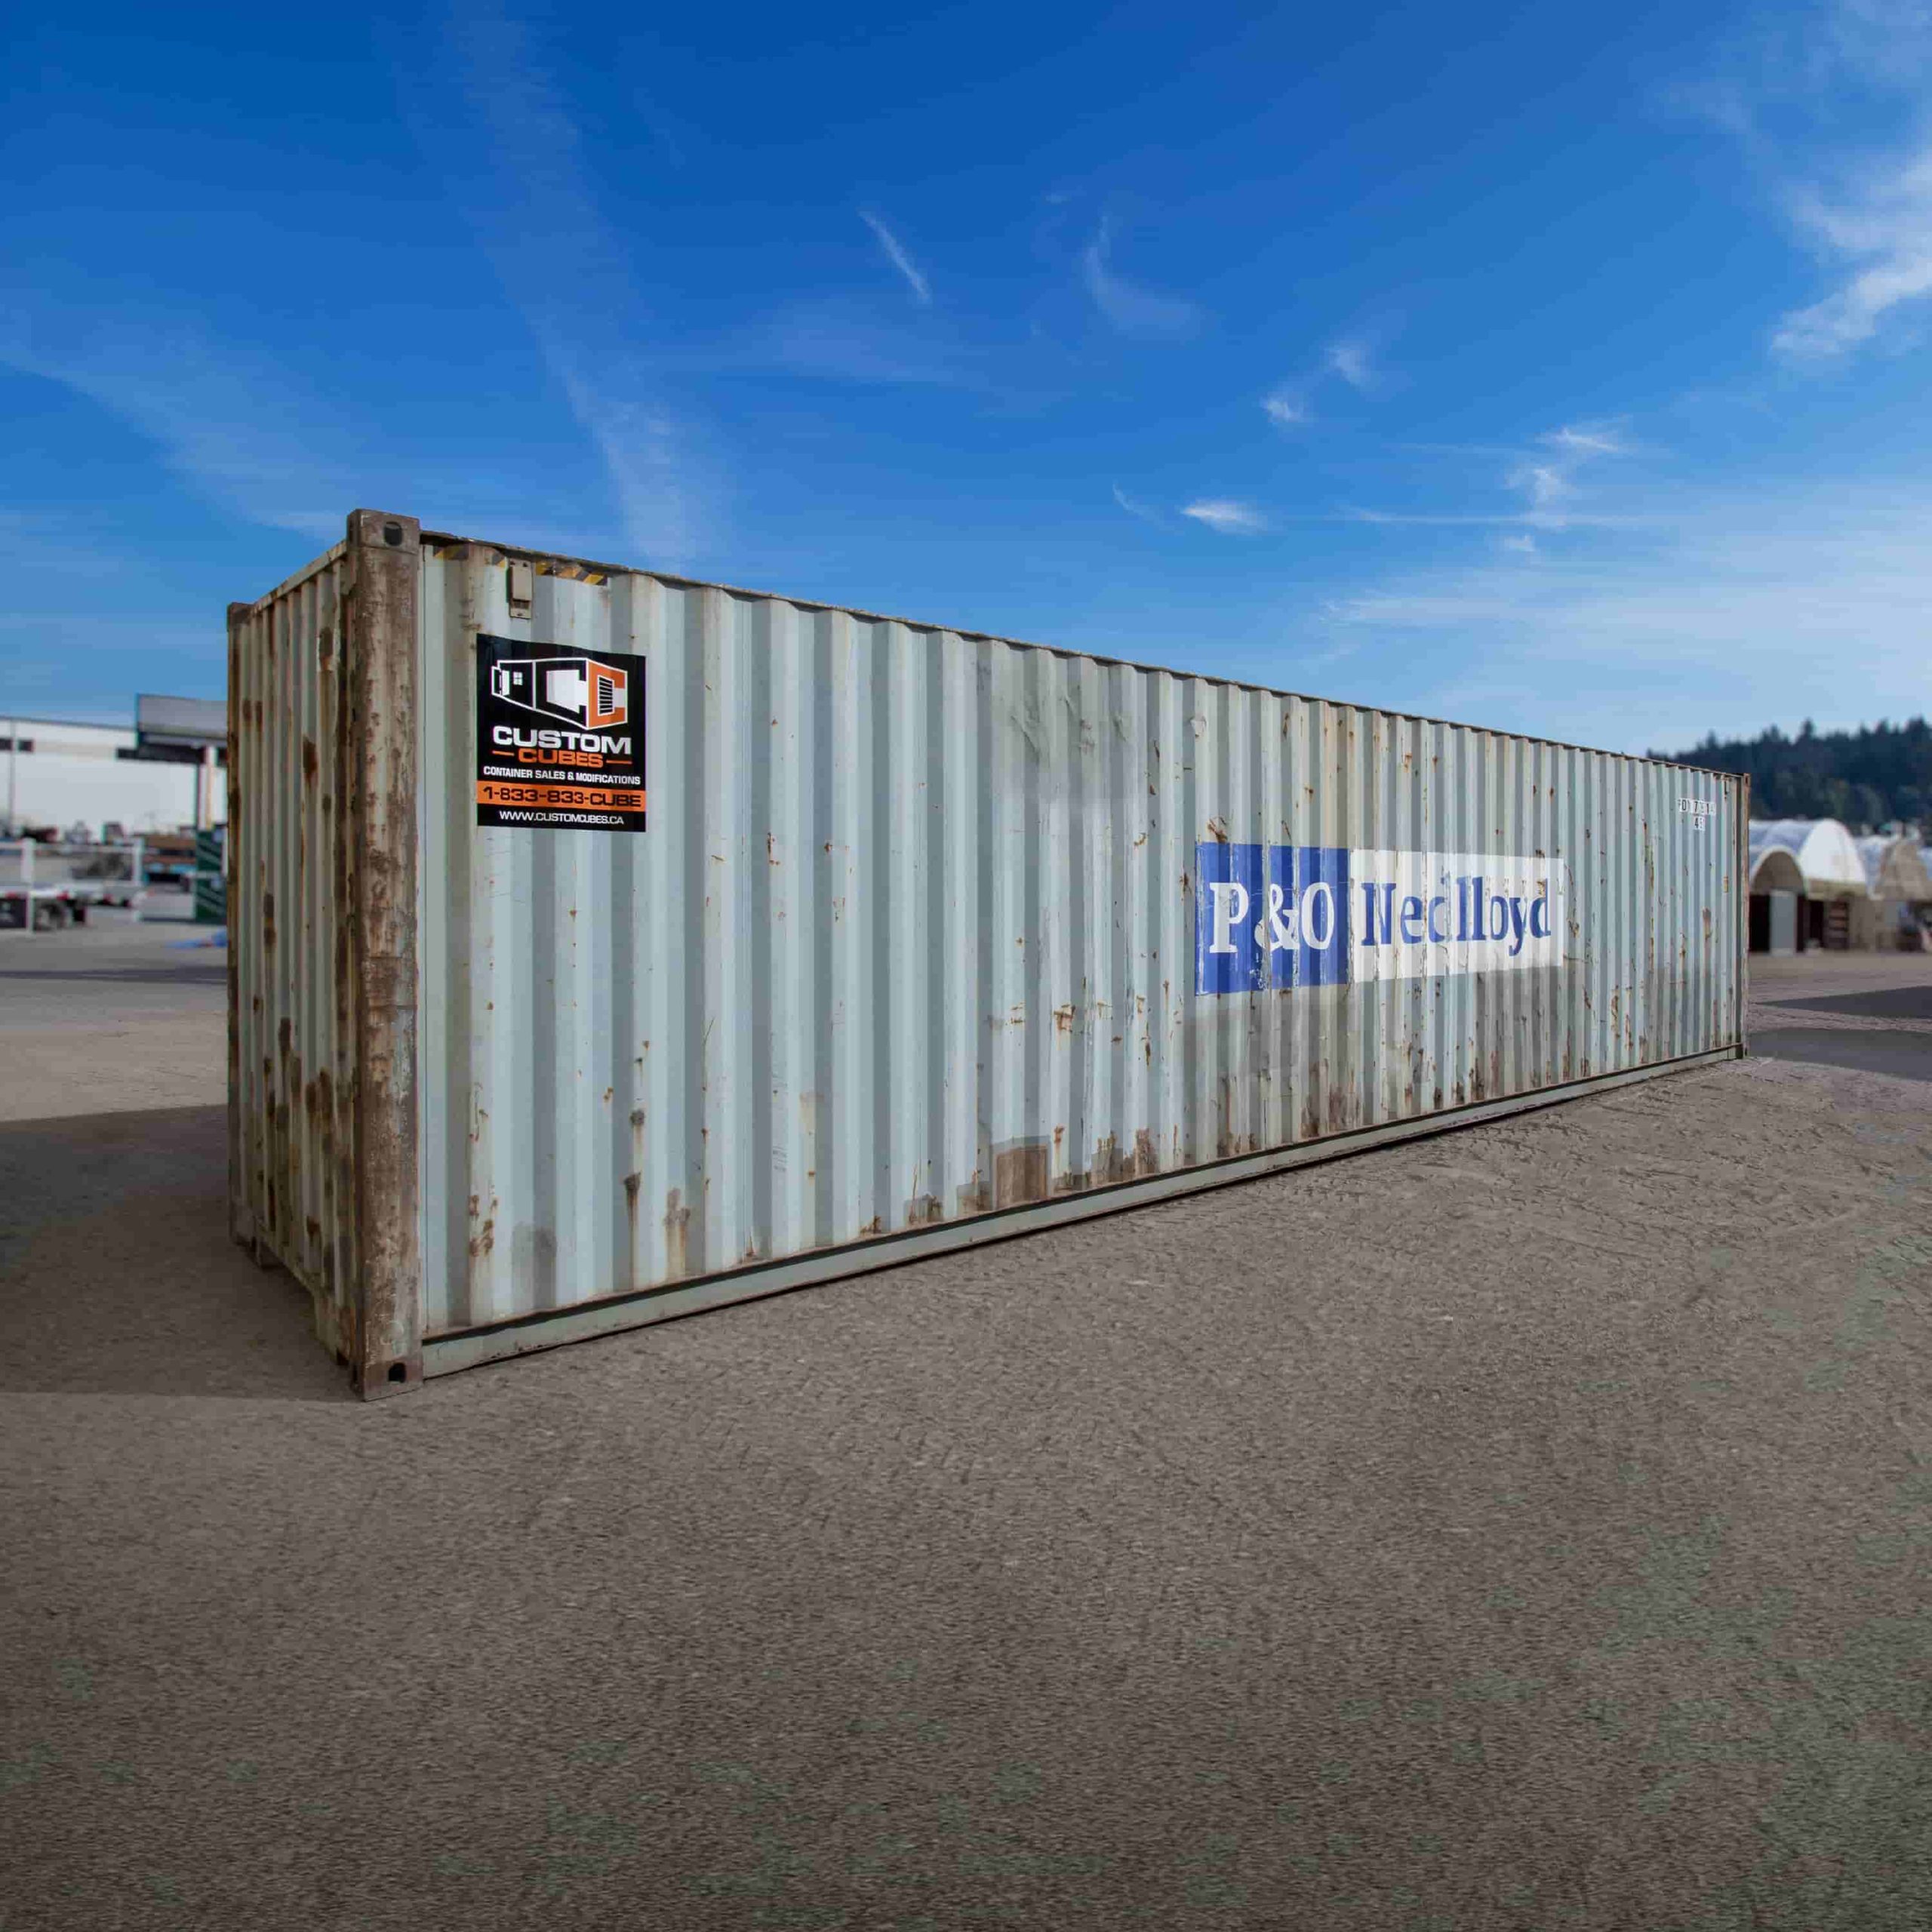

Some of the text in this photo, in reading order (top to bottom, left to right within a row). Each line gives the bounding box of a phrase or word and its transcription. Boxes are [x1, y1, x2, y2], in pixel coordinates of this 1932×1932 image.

[493, 725, 632, 755] CUSTOM
[518, 748, 604, 768] CUBES
[483, 765, 641, 785] CONTAINER SALES & MODIFICATIONS
[483, 786, 641, 808] 1-833-833-CUBE
[499, 811, 624, 825] WWW.CUSTOMCUBES.CA
